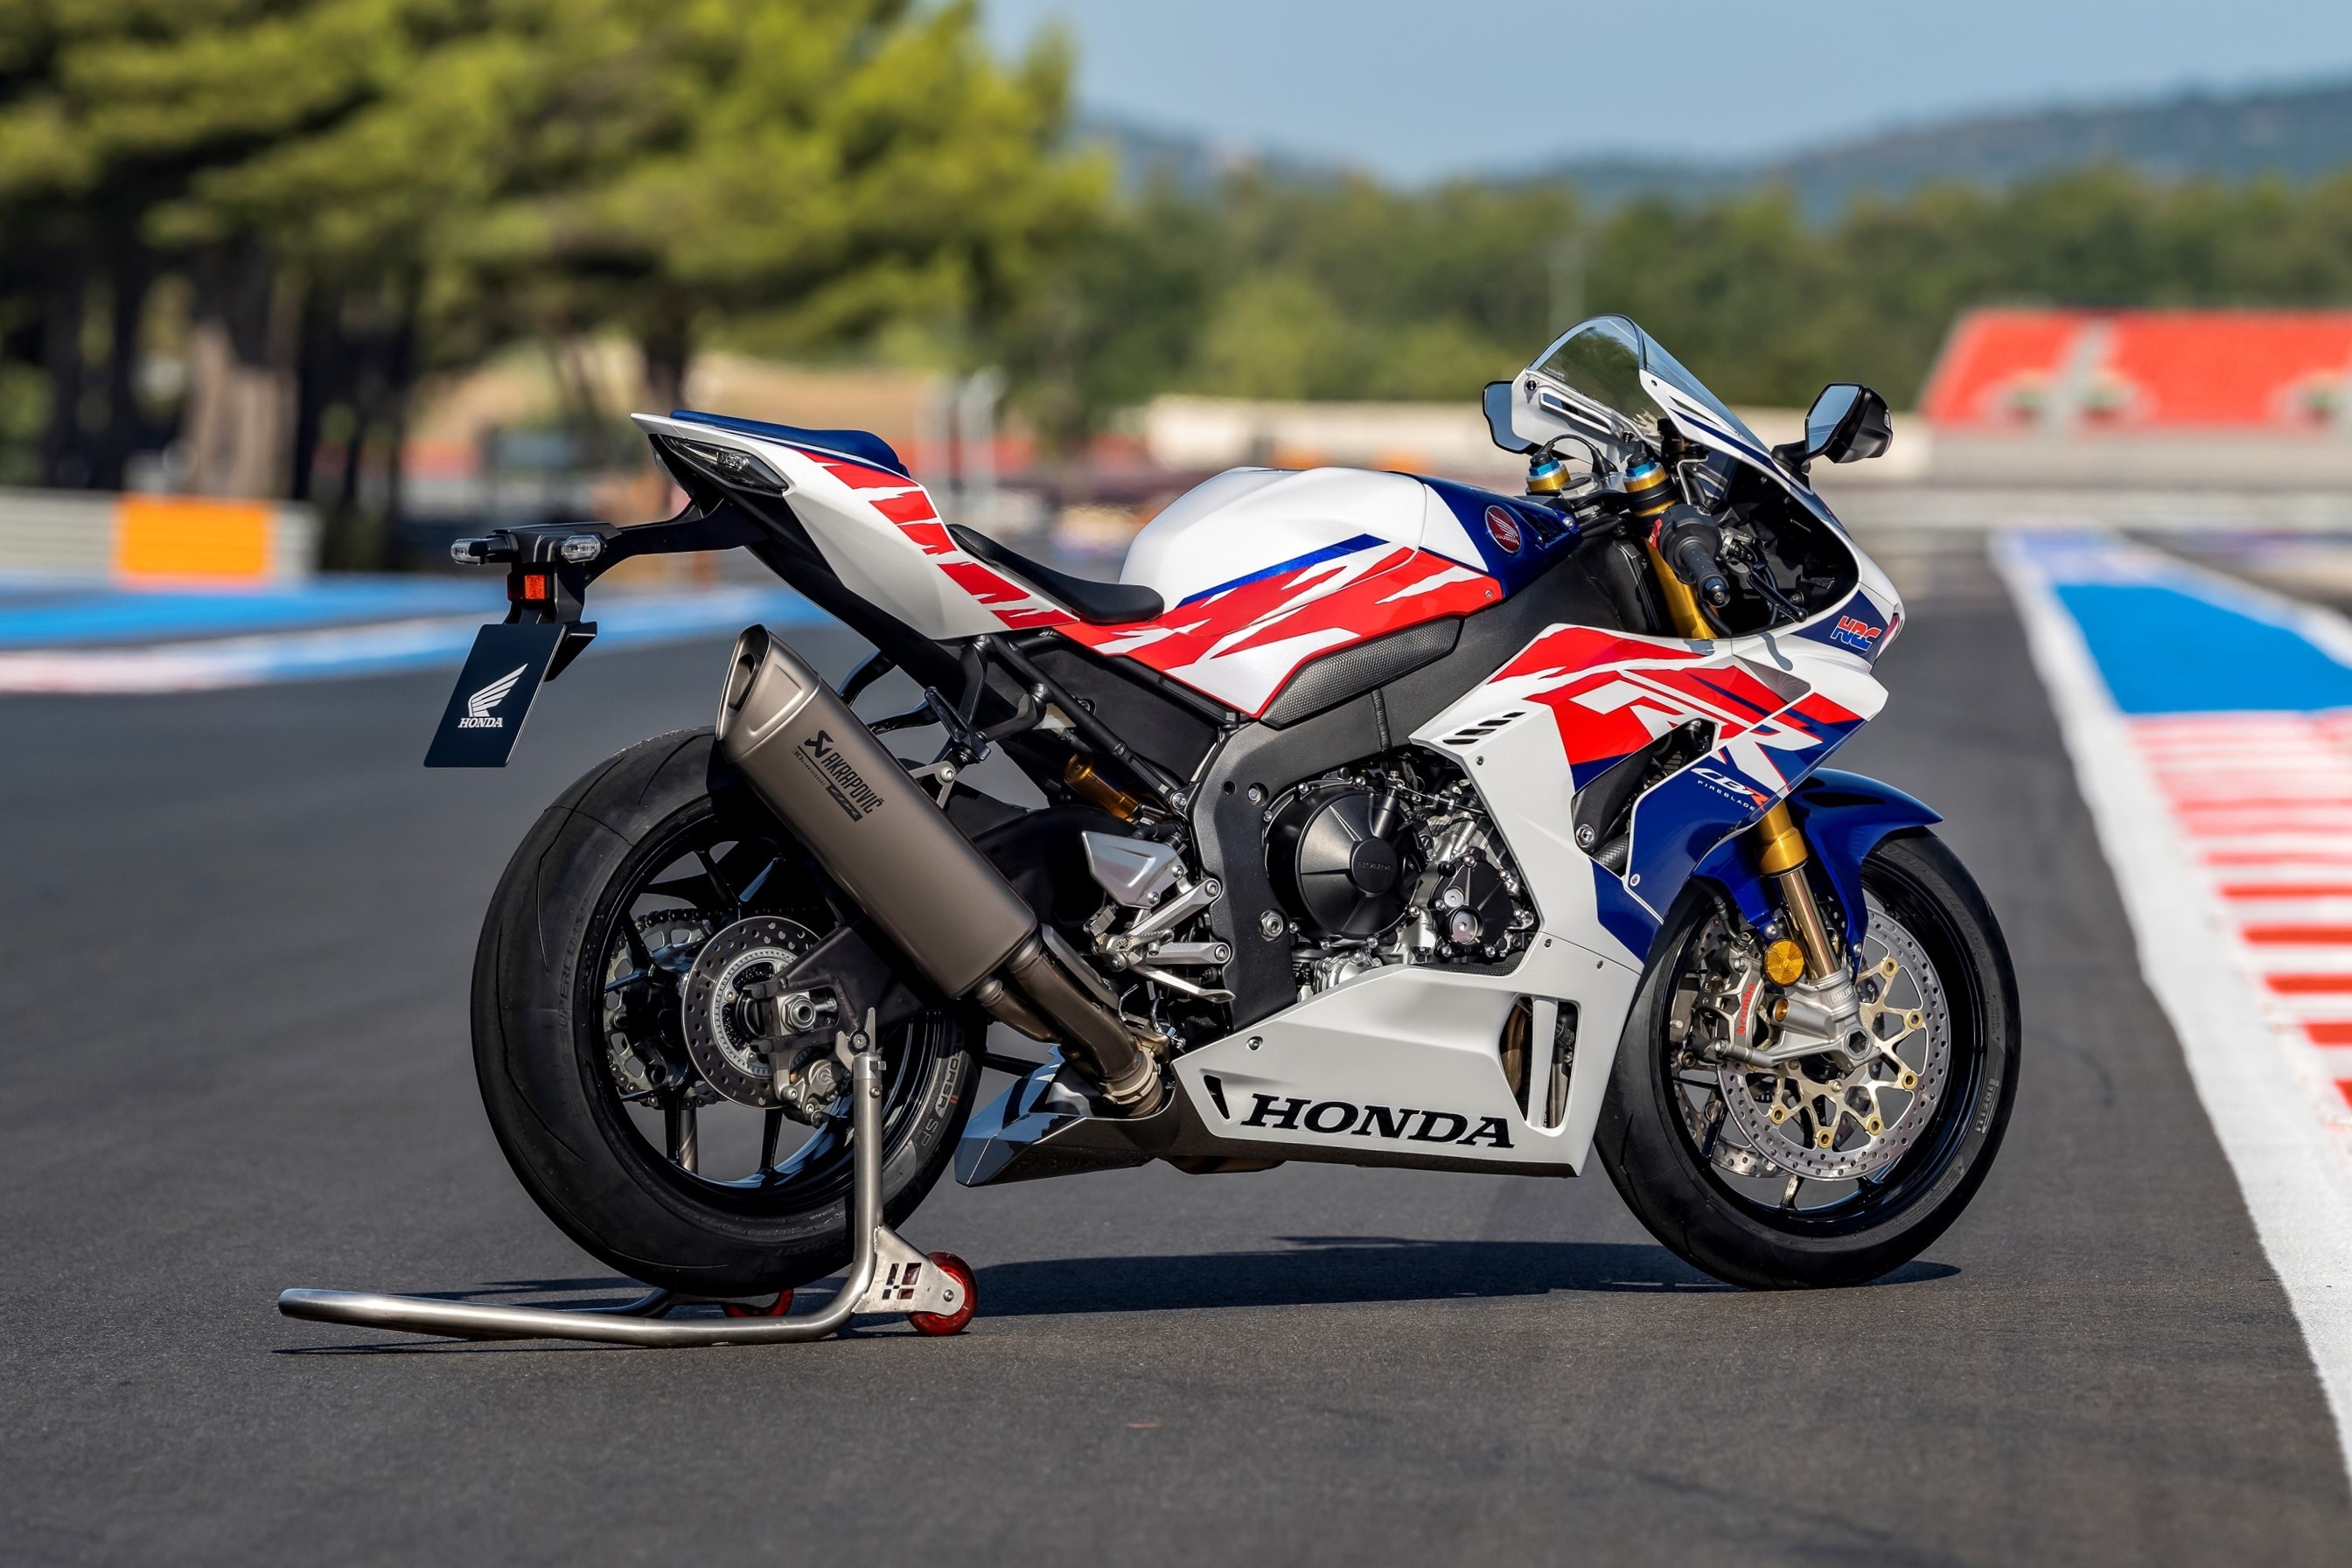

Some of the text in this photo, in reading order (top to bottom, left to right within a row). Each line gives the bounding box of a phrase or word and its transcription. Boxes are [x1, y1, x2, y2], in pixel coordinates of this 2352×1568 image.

[1830, 615, 1882, 652] HRC
[457, 717, 503, 728] HONDA
[820, 752, 885, 815] AKRAPOVIČ
[1691, 768, 1769, 812] CBR
[1698, 780, 1755, 812] FIREBLADE
[1736, 983, 1756, 1035] brembo
[1239, 1092, 1515, 1149] HONDA
